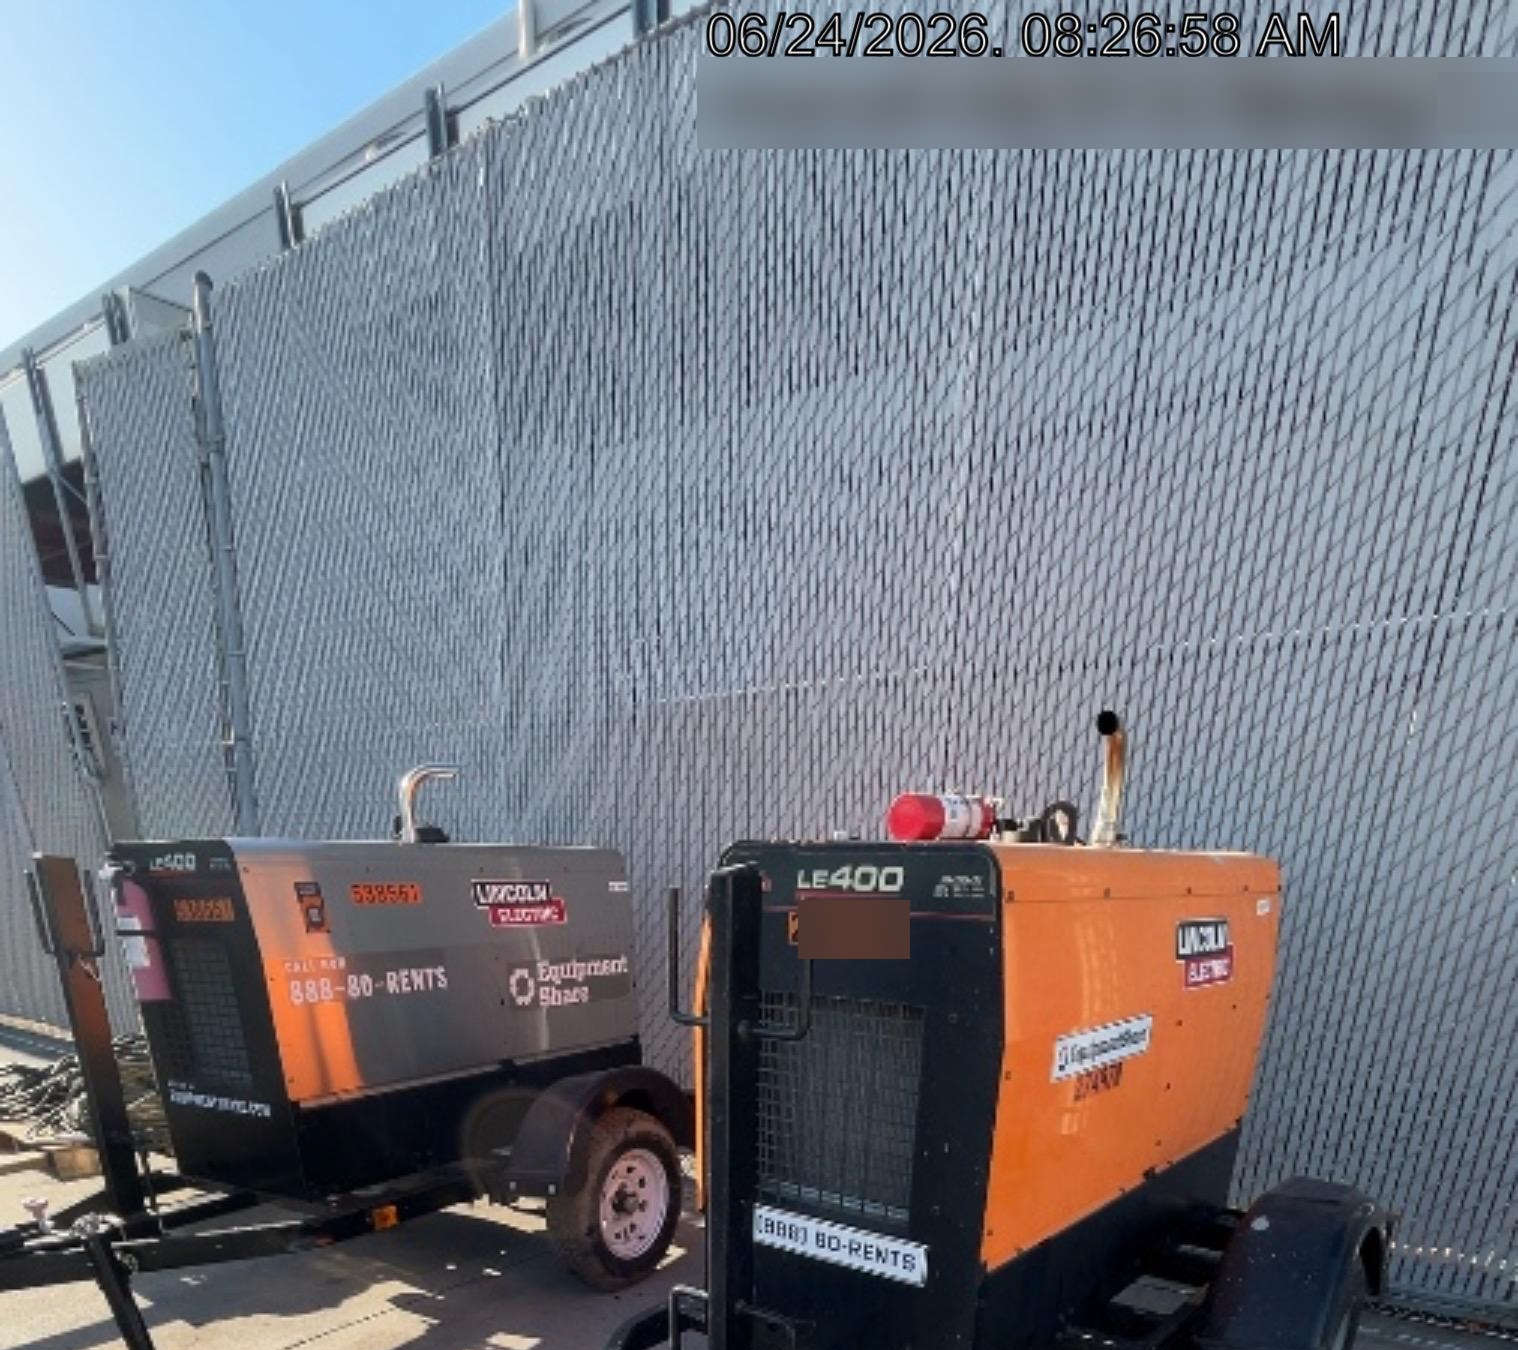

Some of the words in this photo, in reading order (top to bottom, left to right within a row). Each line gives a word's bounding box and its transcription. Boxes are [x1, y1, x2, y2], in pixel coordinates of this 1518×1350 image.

[797, 864, 904, 892] LE400
[475, 884, 548, 905] LINCOLN
[1178, 922, 1228, 955] LINCOLN
[537, 953, 628, 985] Equipment
[289, 965, 449, 1006] 888-80-RENTS
[539, 986, 589, 1006] Share
